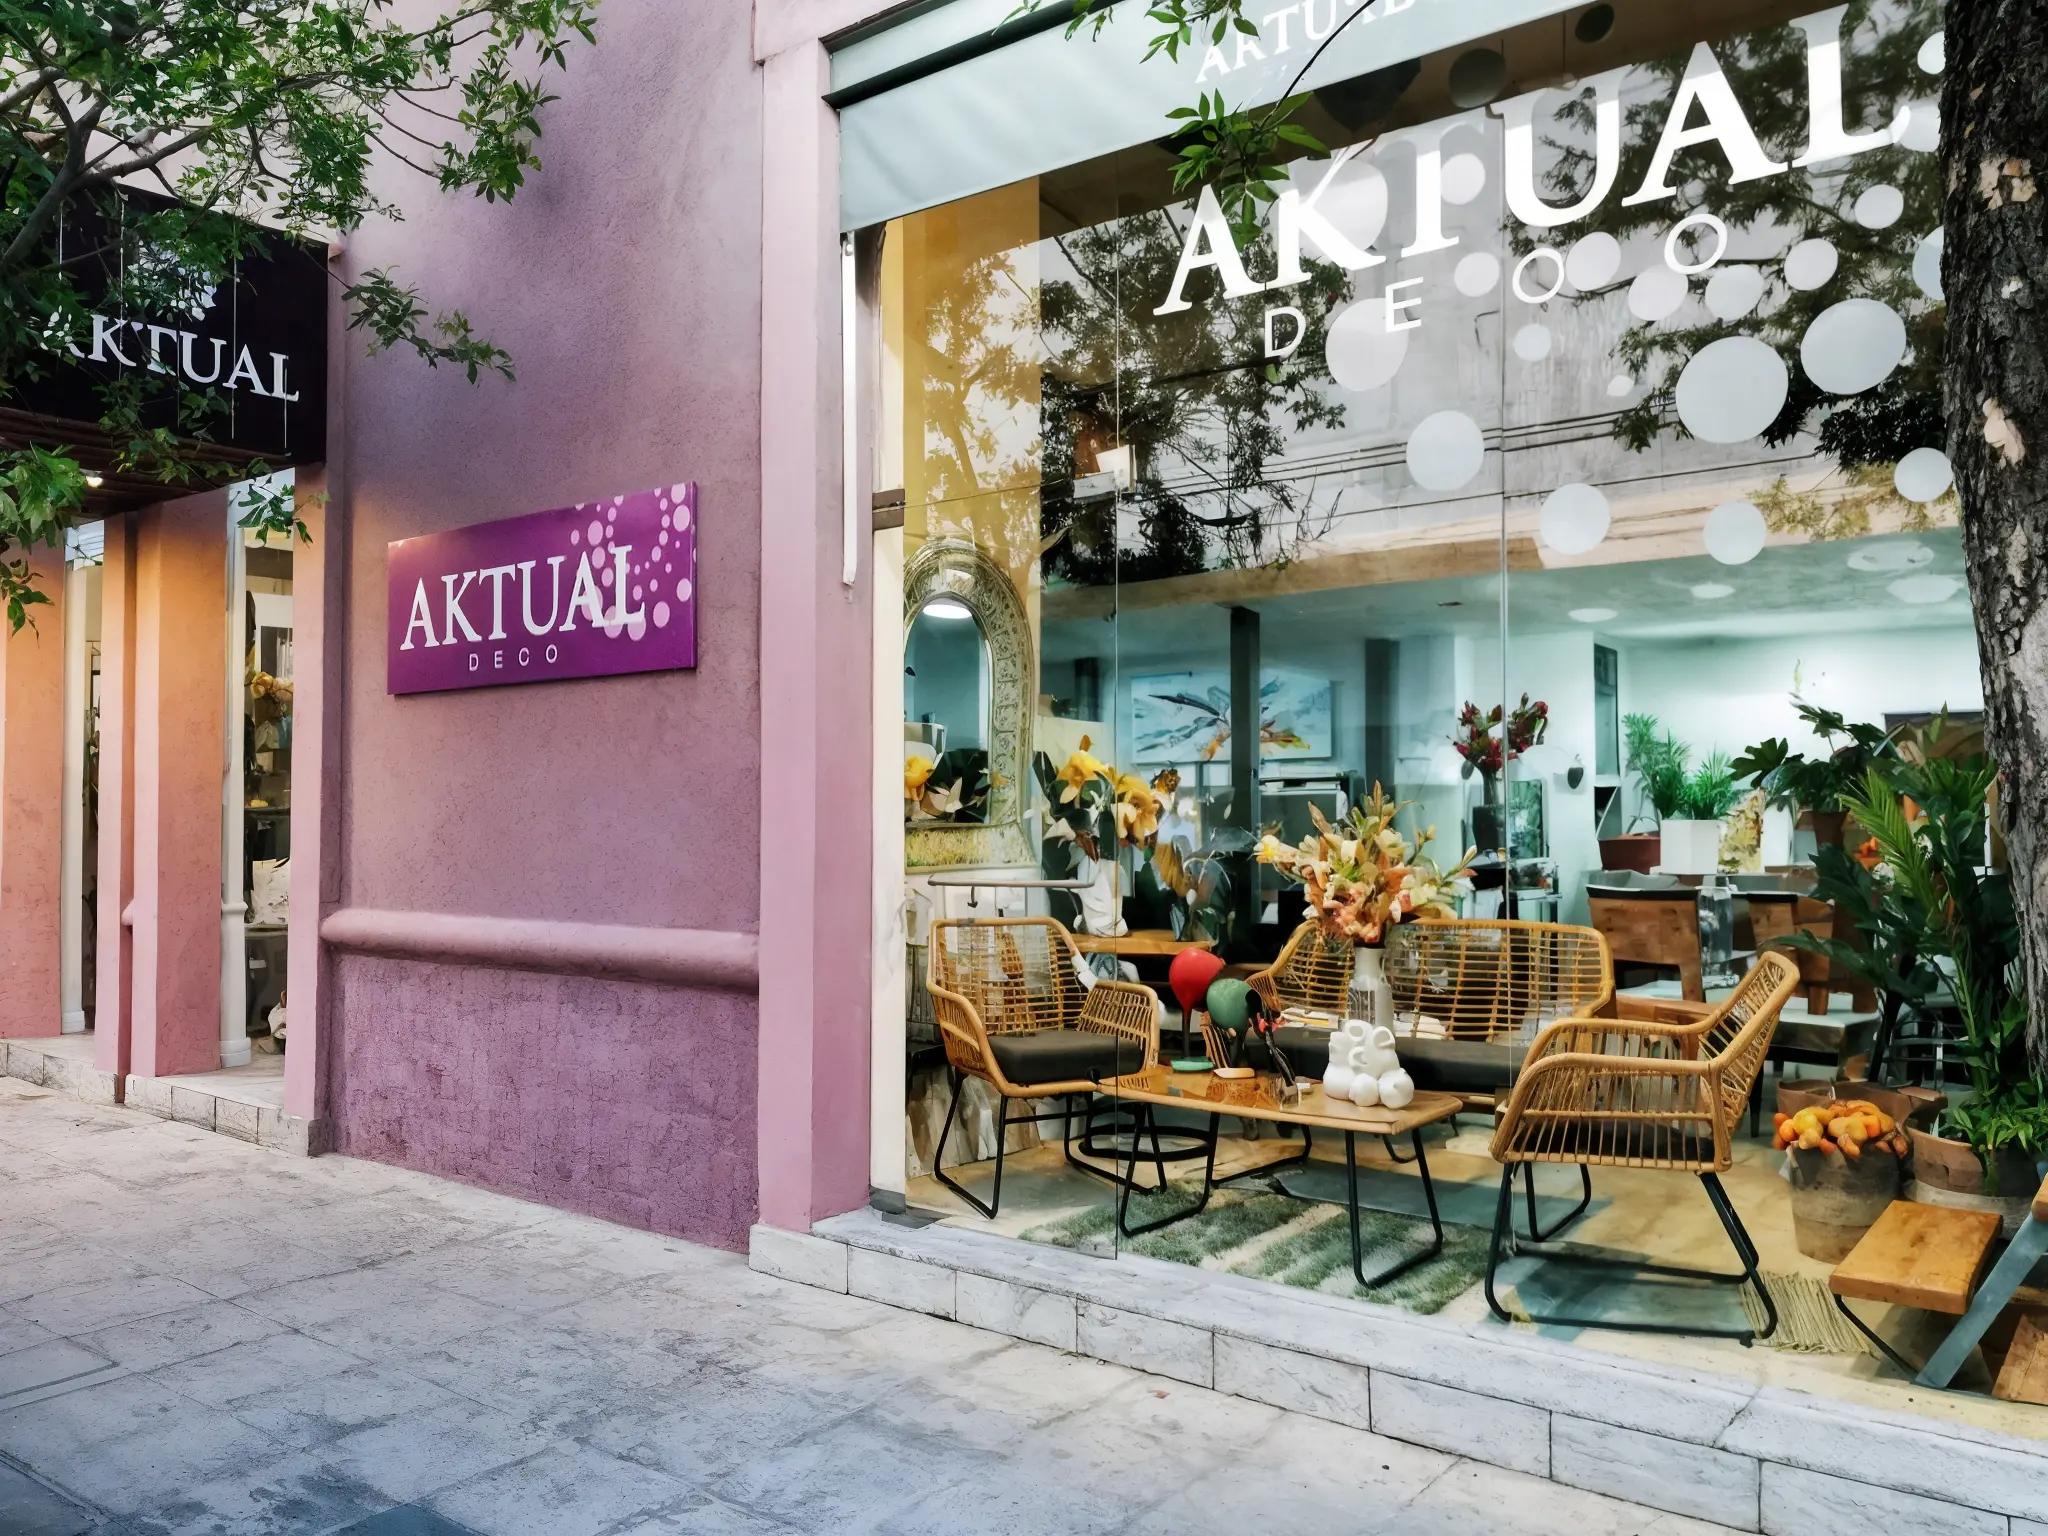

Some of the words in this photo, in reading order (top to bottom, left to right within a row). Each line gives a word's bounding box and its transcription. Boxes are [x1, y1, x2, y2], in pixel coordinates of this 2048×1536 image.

[1153, 3, 1911, 317] AKTUAL
[400, 544, 645, 650] AKTUAL
[469, 644, 558, 671] DECO
